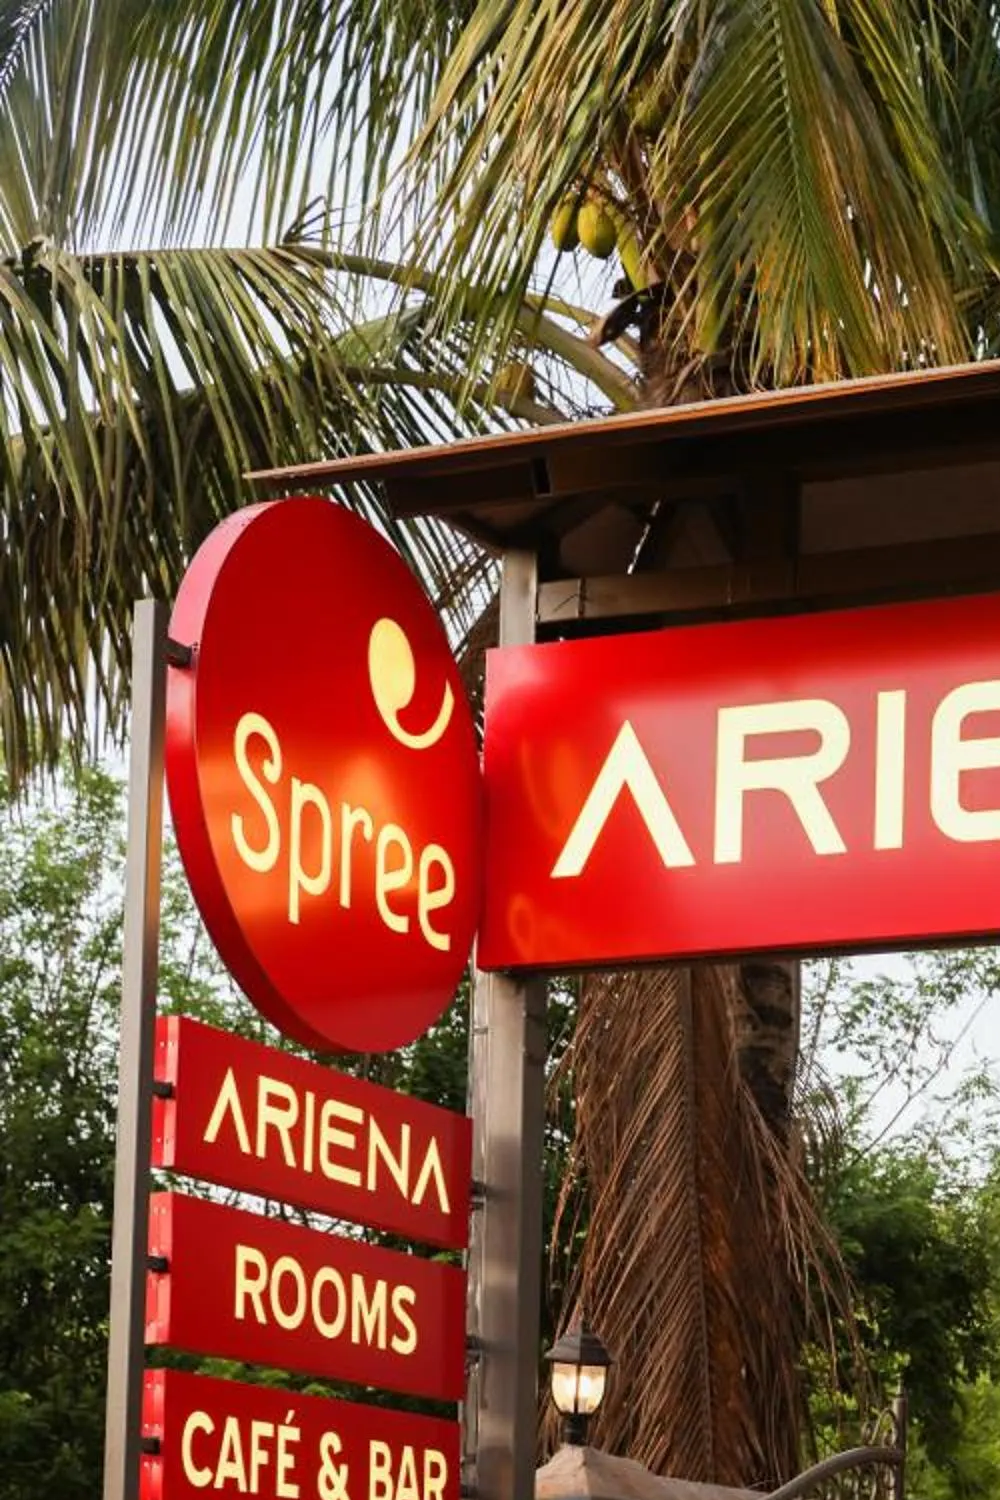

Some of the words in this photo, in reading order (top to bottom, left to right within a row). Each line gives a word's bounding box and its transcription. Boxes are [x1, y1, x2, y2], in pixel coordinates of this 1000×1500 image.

[230, 712, 456, 952] Spree
[203, 1067, 451, 1214] ARIENA
[234, 1243, 418, 1356] ROOMS
[181, 1409, 302, 1499] CAFÉ
